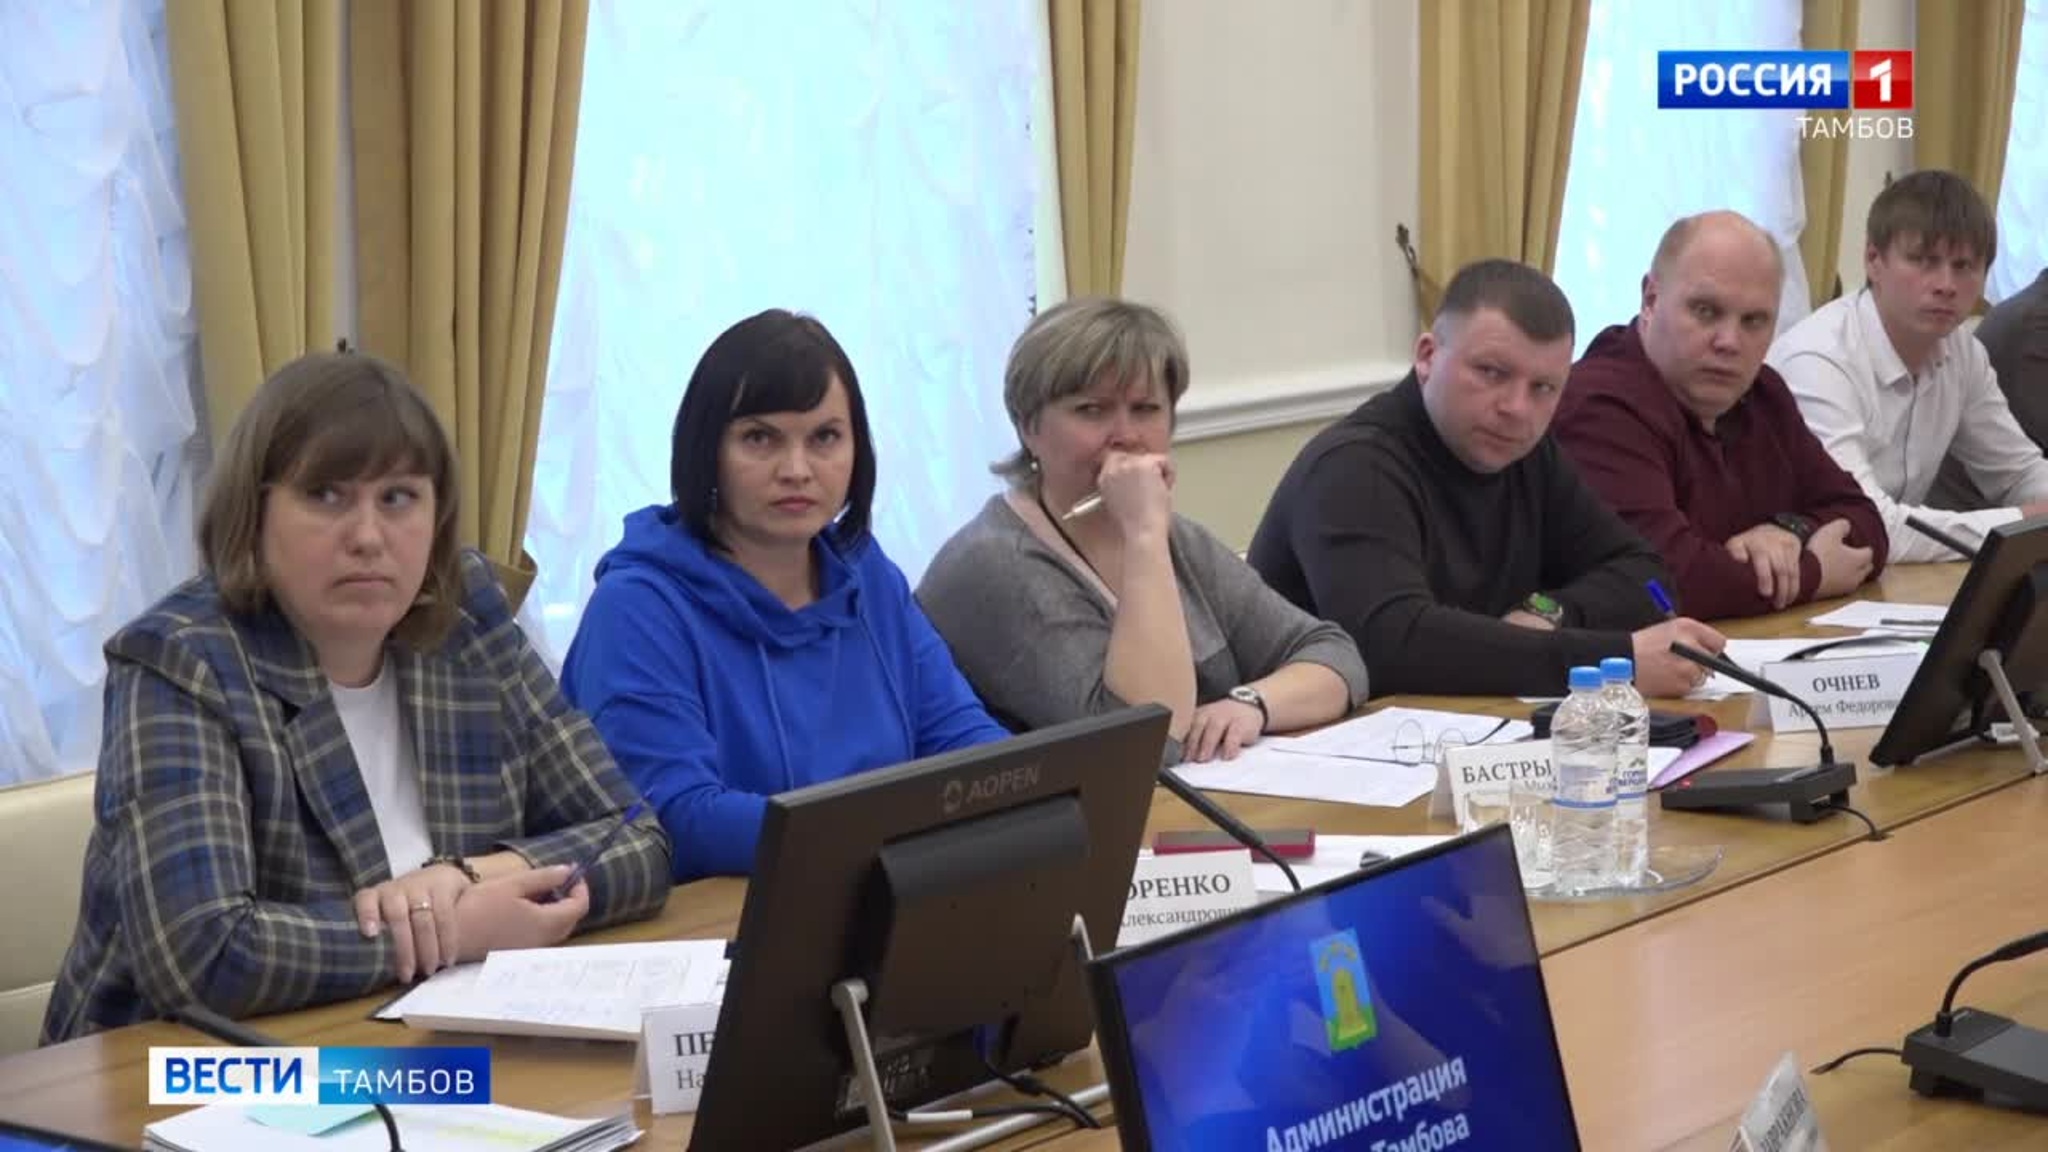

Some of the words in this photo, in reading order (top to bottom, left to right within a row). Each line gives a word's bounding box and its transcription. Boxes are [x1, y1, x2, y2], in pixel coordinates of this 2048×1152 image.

[1812, 673, 1881, 694] ОЧНЕВ
[1788, 702, 1833, 718] Арем
[965, 766, 1040, 804] AOPEN
[1266, 1056, 1469, 1152] Администрация
